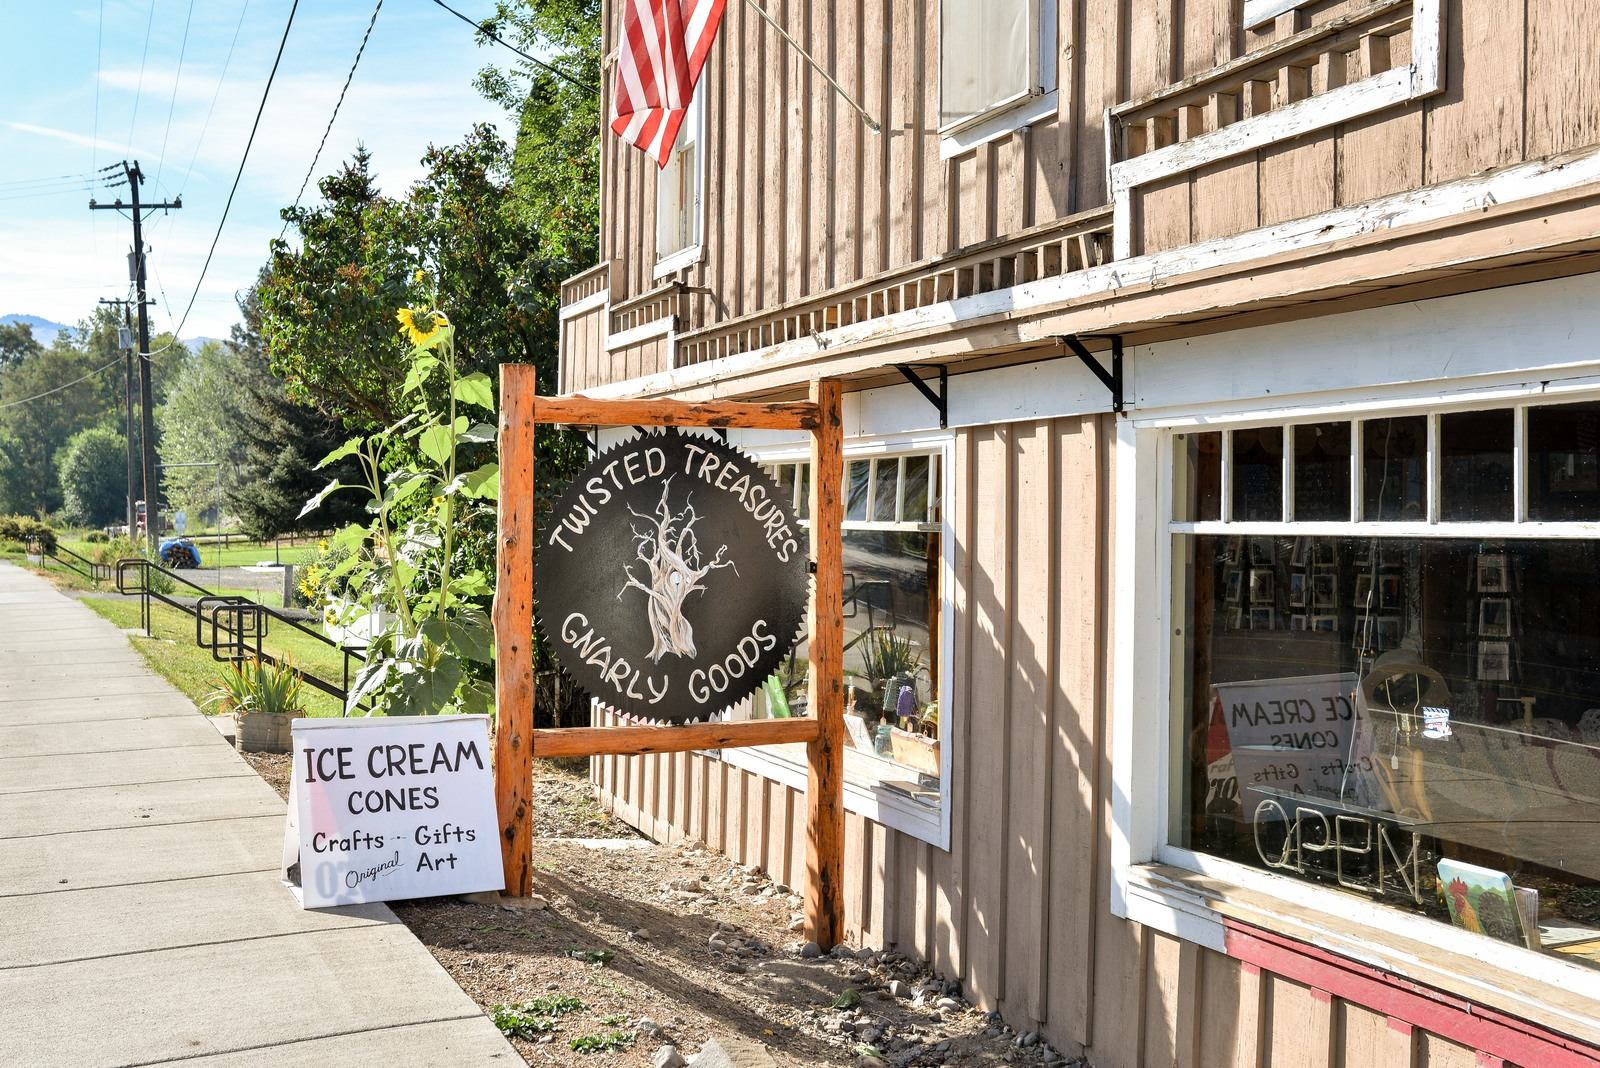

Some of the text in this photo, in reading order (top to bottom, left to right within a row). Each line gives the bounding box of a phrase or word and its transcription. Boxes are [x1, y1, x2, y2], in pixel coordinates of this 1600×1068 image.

[549, 443, 798, 563] TWISTED TREASURES
[561, 612, 777, 704] GNARLY GOODS
[303, 740, 484, 783] ICE CREAM
[347, 786, 440, 815] CONES
[312, 823, 476, 853] Crafts Gifts
[1254, 799, 1423, 905] OPEN
[345, 850, 401, 889] Original
[416, 852, 458, 873] Art
